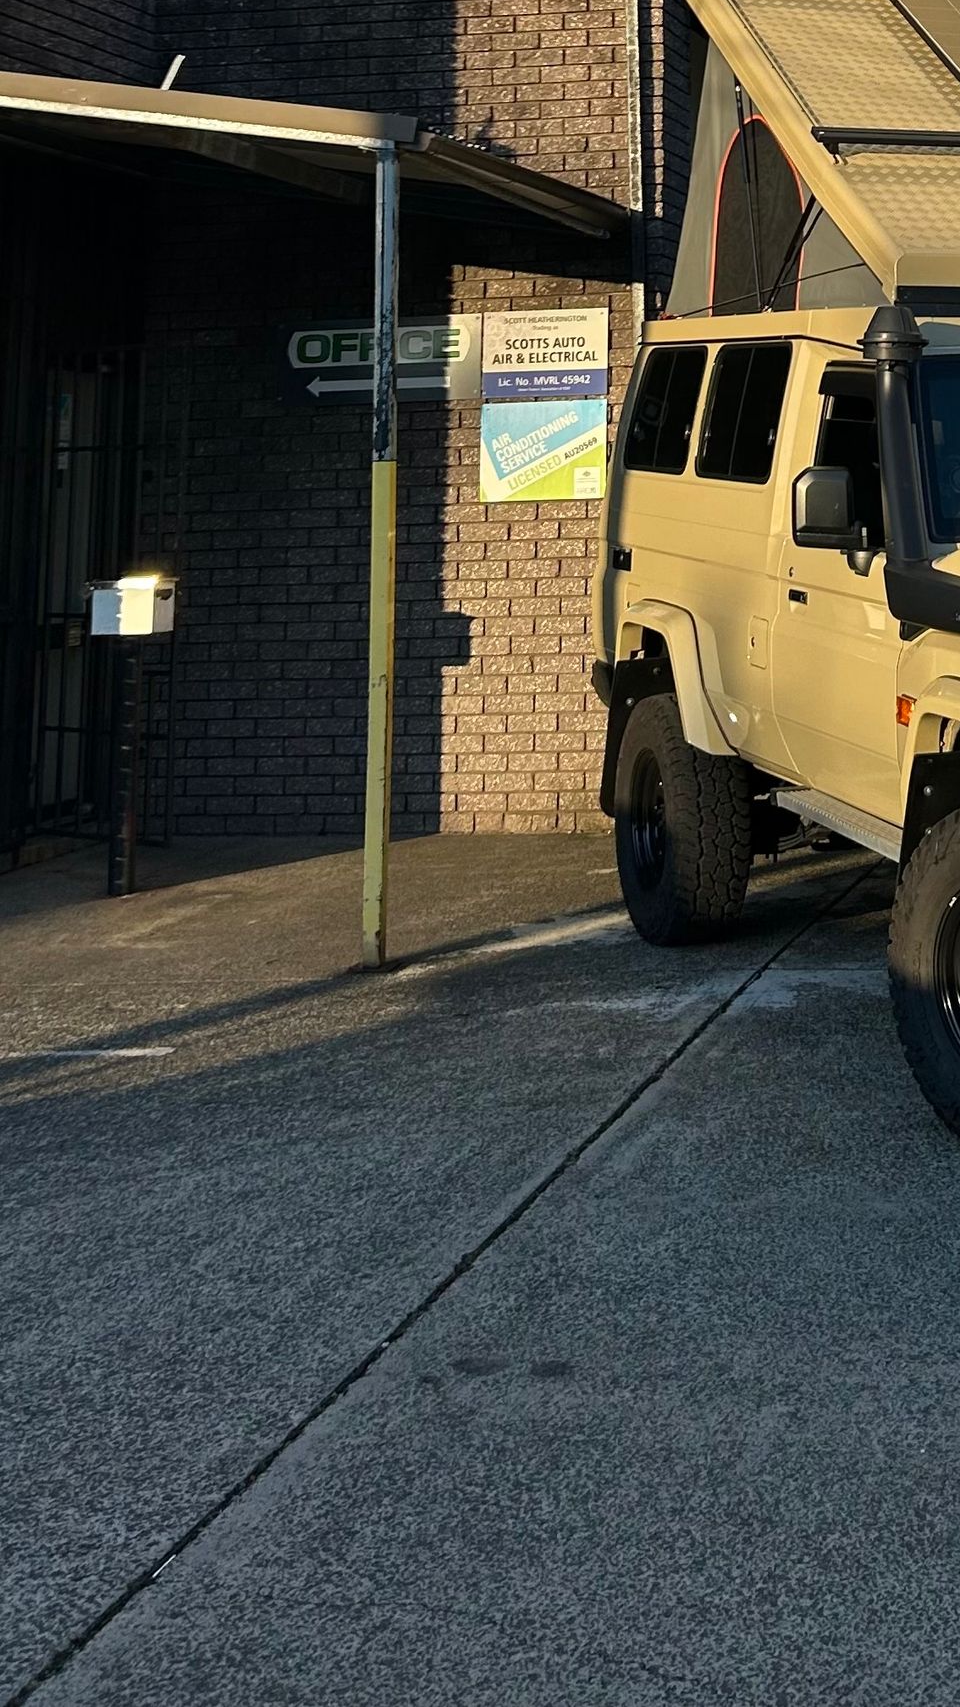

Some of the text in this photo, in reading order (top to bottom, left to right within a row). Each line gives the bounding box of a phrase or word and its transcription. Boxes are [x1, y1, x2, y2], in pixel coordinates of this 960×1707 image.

[297, 328, 461, 364] OFFCE
[505, 336, 586, 350] SCOTTS AUTO
[492, 351, 599, 365] AIR & ELECTRICAL
[498, 374, 591, 387] Lic. No. MVRL 45942
[491, 432, 513, 452] AIR
[495, 411, 579, 462] CONDITIONING
[500, 440, 549, 474] SERVICE
[507, 454, 562, 491] LICENSED
